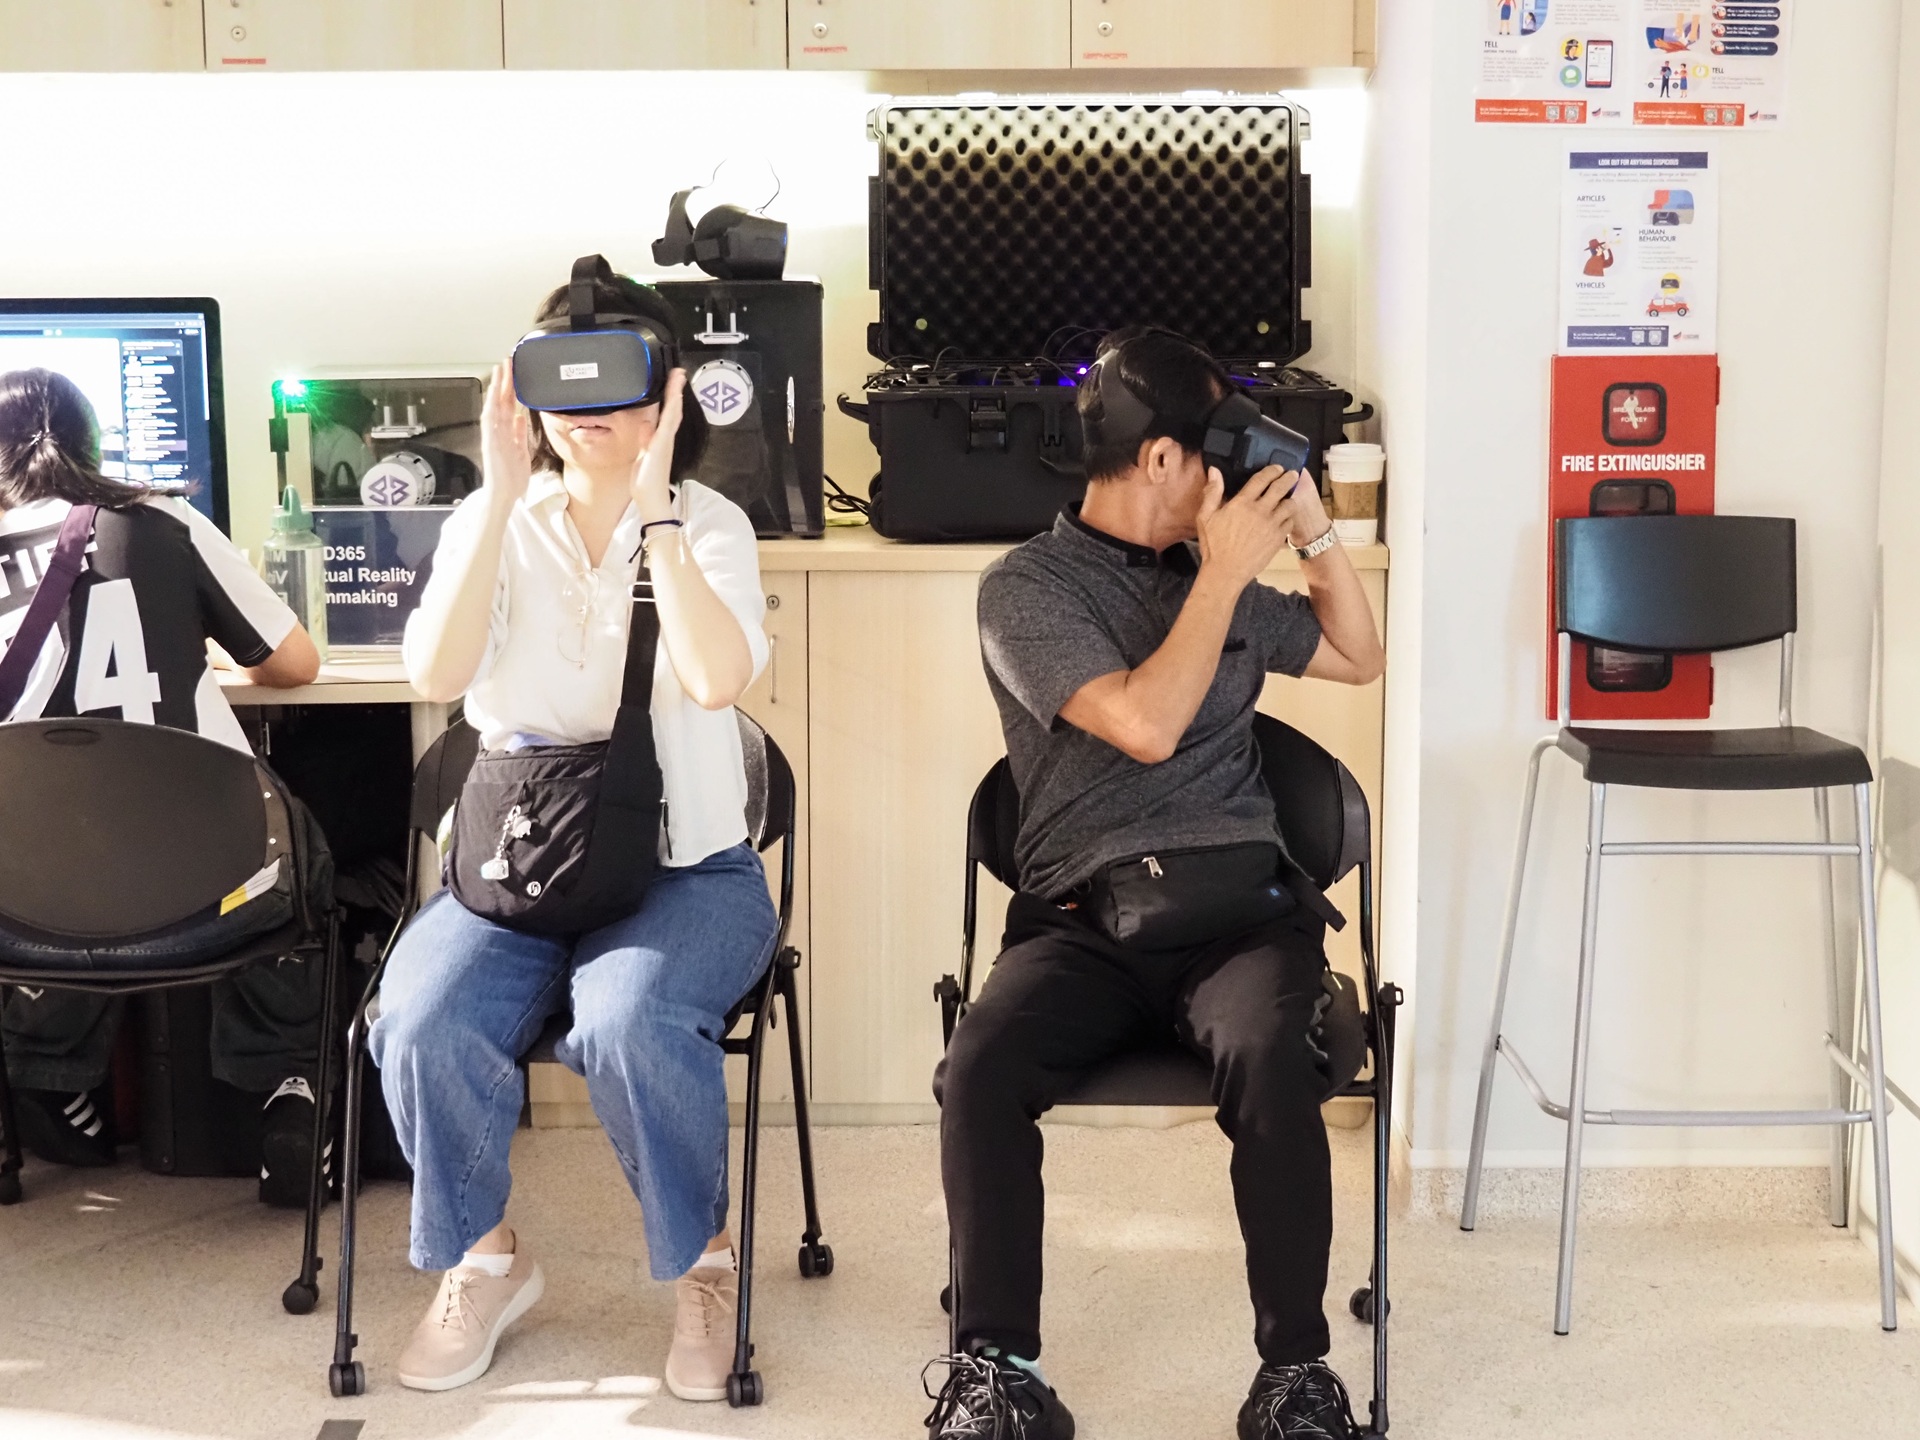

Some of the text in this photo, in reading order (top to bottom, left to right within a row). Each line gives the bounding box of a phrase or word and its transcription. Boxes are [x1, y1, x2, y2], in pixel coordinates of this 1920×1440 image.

[1561, 453, 1706, 472] FIRE EXTINGUISHER
[323, 546, 366, 561] D365
[324, 567, 417, 585] tual Reality
